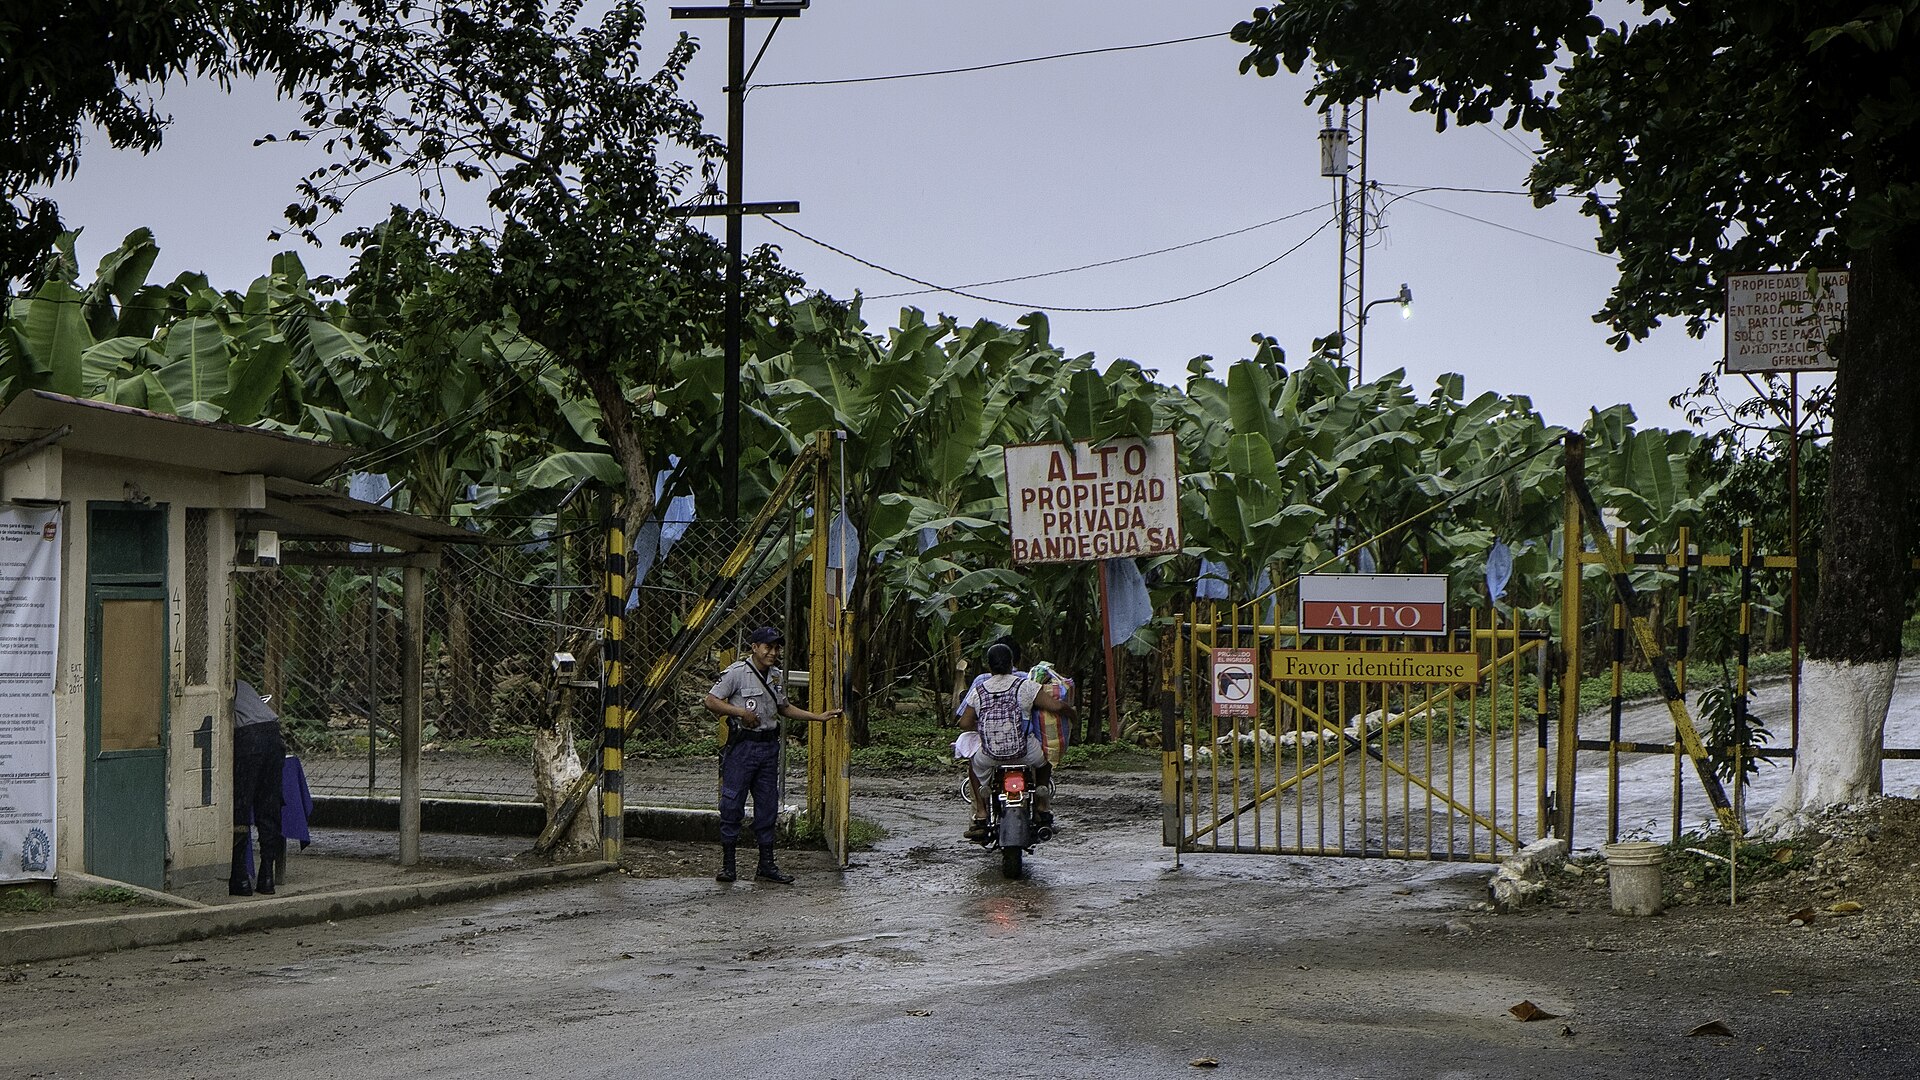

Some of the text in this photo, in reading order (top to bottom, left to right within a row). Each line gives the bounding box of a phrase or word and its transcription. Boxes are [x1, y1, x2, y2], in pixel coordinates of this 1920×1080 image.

[1733, 276, 1799, 291] PROPIEDAD
[1730, 301, 1849, 316] ENTRADA DE ARRO
[1735, 330, 1764, 342] SOLO
[1772, 329, 1787, 340] SE
[1793, 328, 1821, 340] PASA
[1048, 444, 1147, 482] ALTO
[1021, 478, 1165, 512] PROPIEDAD
[1043, 506, 1146, 535] PRIVADA
[1014, 527, 1177, 560] BANDEGUA SA
[1326, 605, 1421, 628] ALTO
[1286, 656, 1465, 678] Favor identificarse
[193, 715, 213, 806] 1
